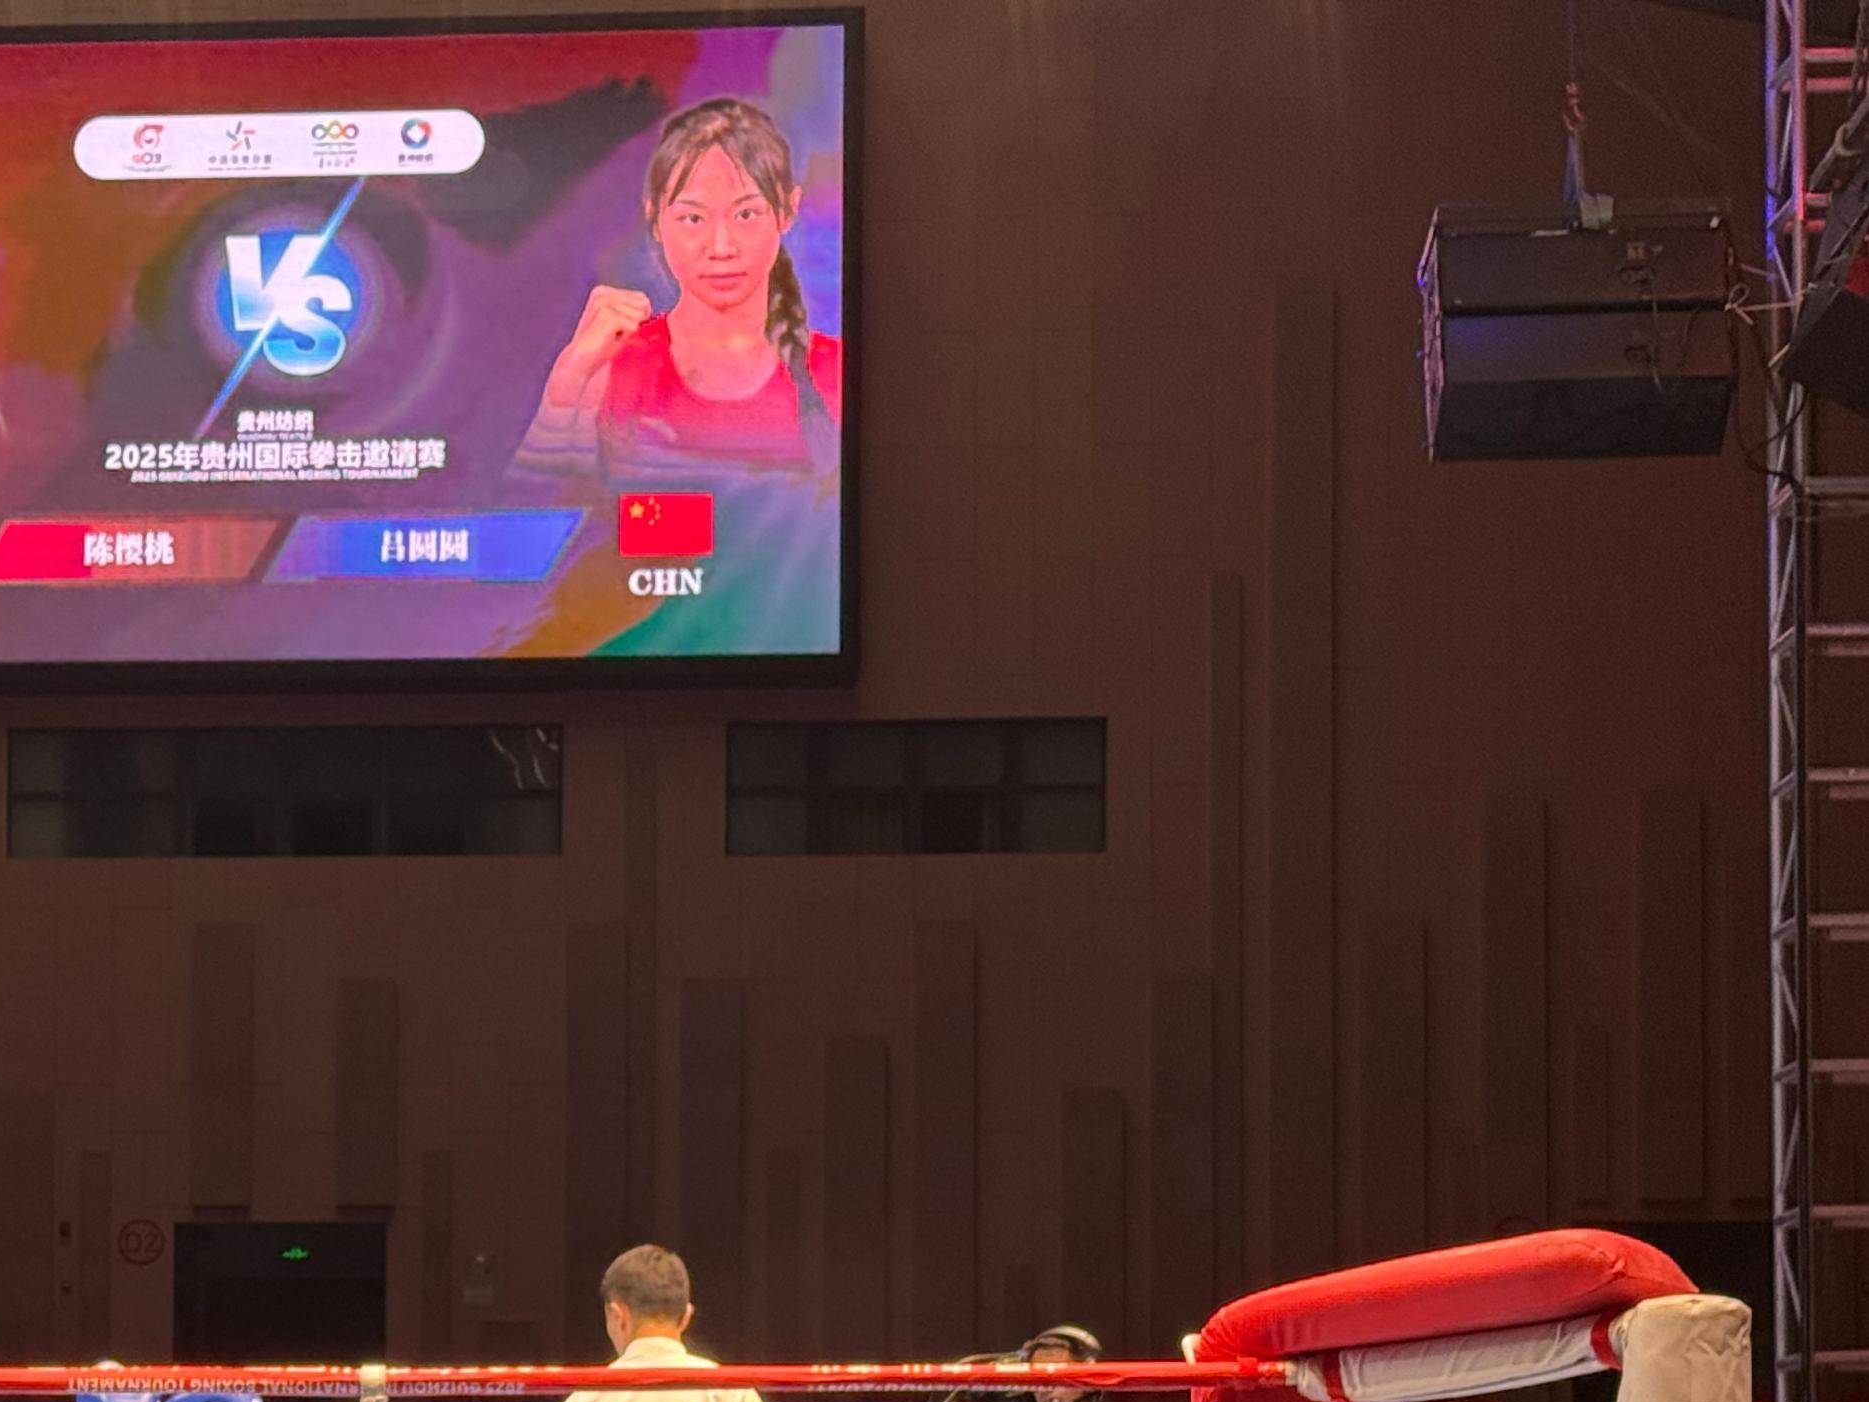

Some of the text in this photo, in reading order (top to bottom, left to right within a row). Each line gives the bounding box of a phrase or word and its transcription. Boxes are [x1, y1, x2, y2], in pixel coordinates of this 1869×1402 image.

[226, 235, 352, 376] VS
[236, 410, 314, 432] 贵州纺织
[105, 438, 446, 470] 2025年贵州国际拳击邀请赛
[84, 531, 175, 566] 陈樱桃
[629, 569, 703, 596] CHN
[68, 1378, 186, 1394] TOURNAMENT
[190, 1379, 256, 1394] BOXING
[401, 1382, 479, 1395] GUIZHOU
[486, 1383, 526, 1395] 2025
